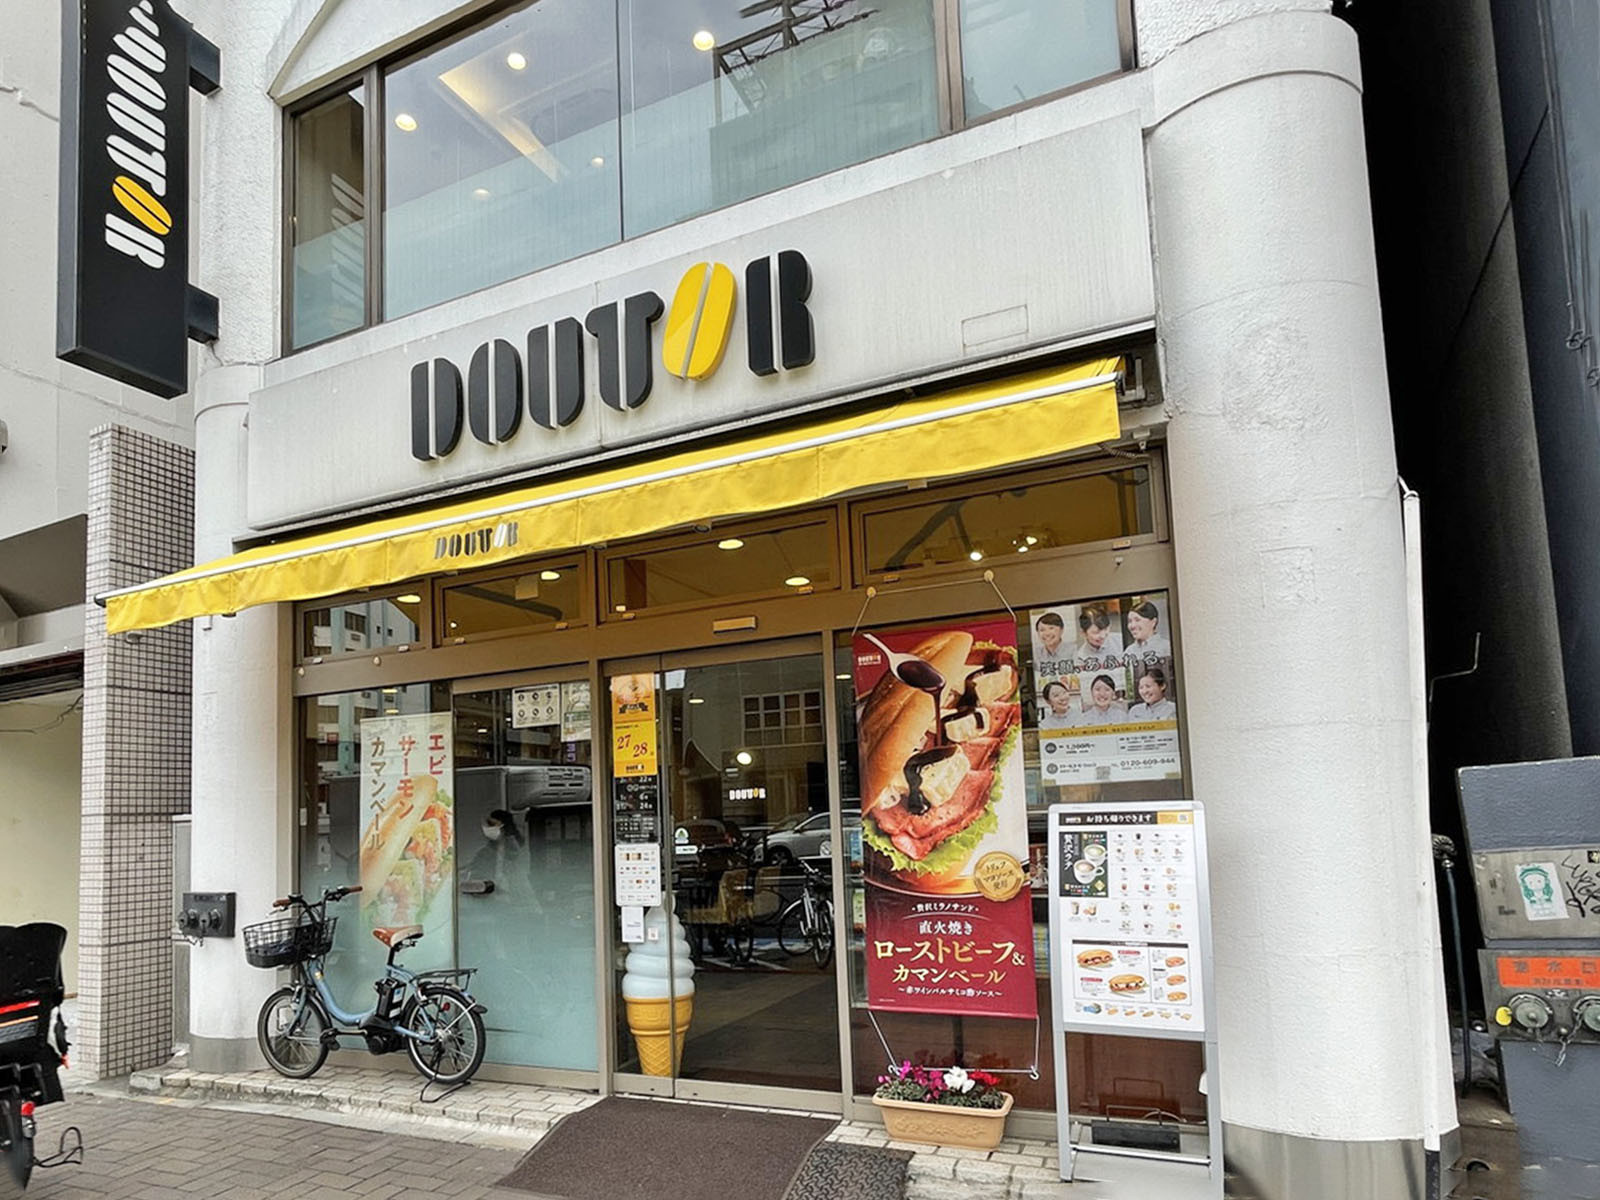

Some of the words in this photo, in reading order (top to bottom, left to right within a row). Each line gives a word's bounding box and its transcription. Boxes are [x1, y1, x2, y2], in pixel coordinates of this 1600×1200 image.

[411, 250, 816, 461] DOUTOR
[434, 522, 518, 559] DOUTOR
[428, 734, 447, 775] エビ
[616, 734, 631, 750] 27
[632, 741, 648, 757] 28
[397, 735, 416, 820] サーモン
[369, 737, 386, 850] カマンベール
[729, 788, 766, 800] DOUTOR
[919, 920, 973, 935] 直火焼き
[874, 937, 1026, 966] ローストビーフ&
[892, 964, 1007, 985] カマンベール
